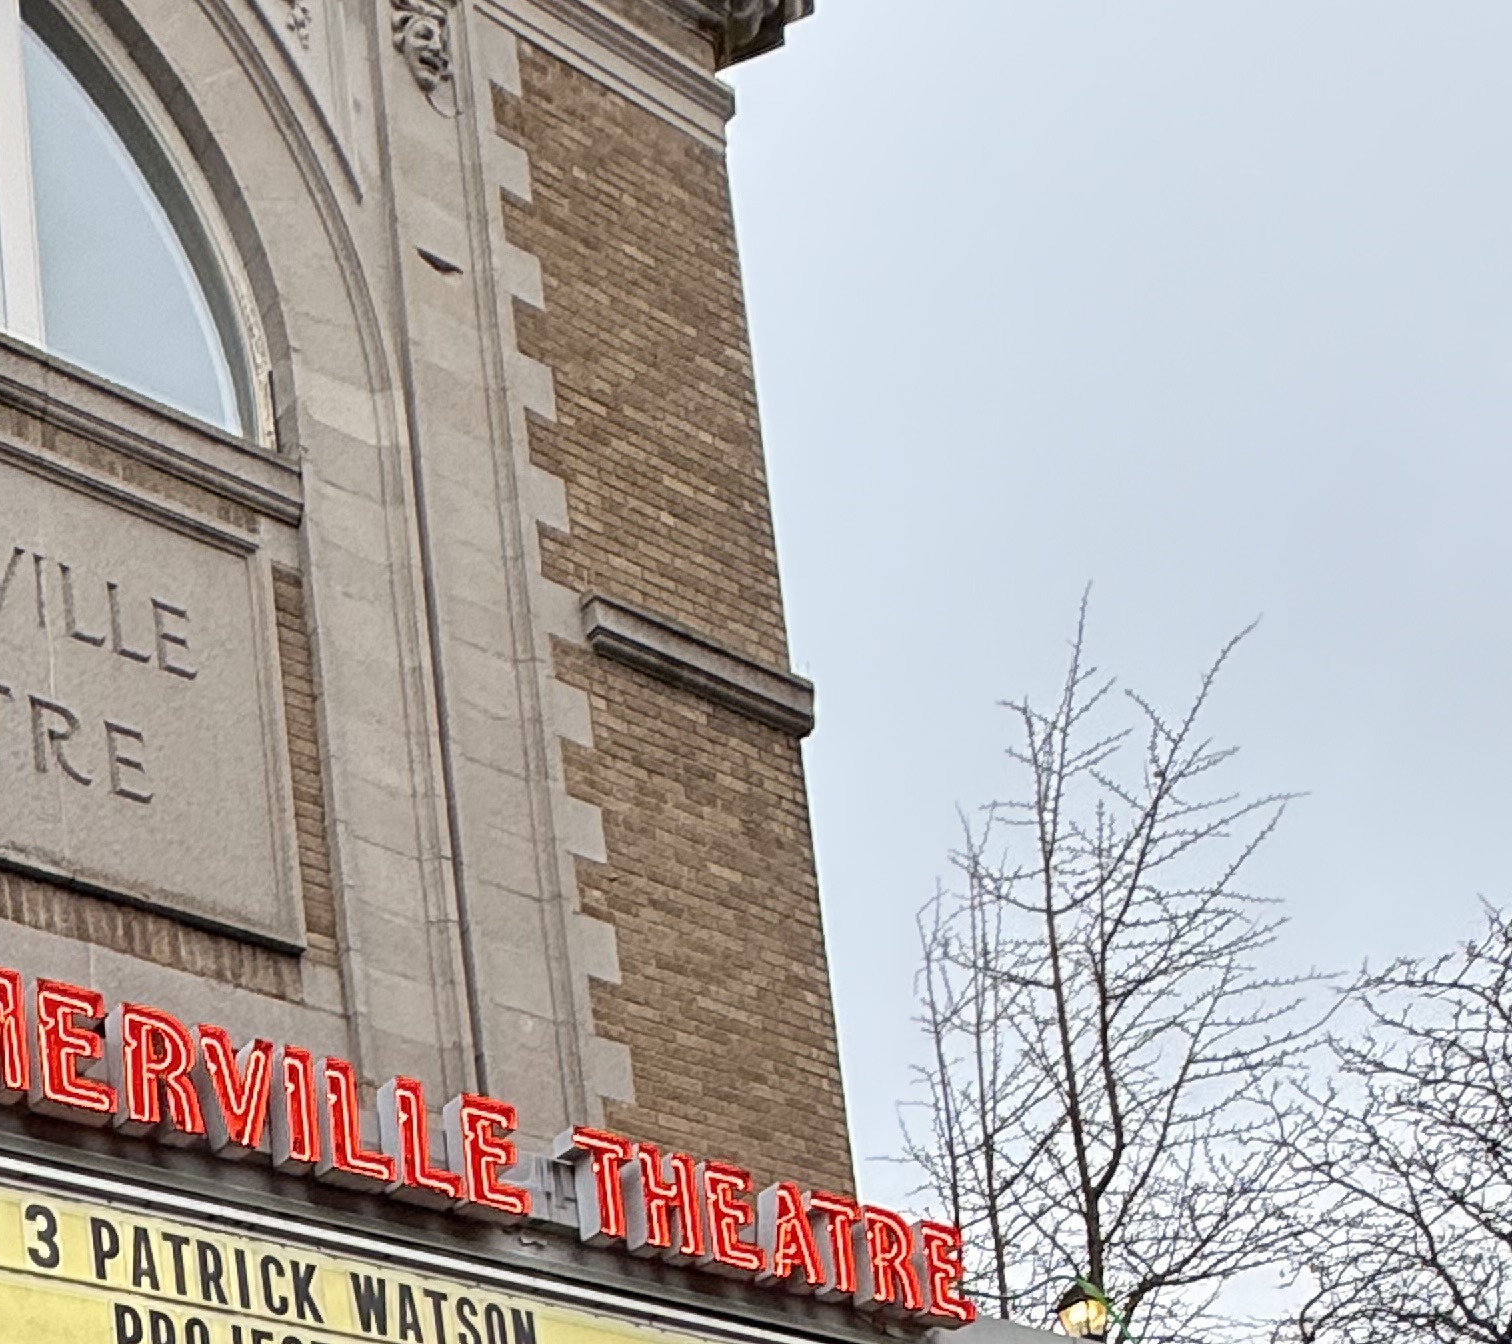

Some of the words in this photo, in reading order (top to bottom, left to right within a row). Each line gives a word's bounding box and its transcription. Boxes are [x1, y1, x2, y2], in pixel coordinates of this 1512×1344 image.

[23, 1204, 61, 1269] 3
[89, 1216, 325, 1324] PATRICK
[571, 1124, 978, 1324] THEATRE
